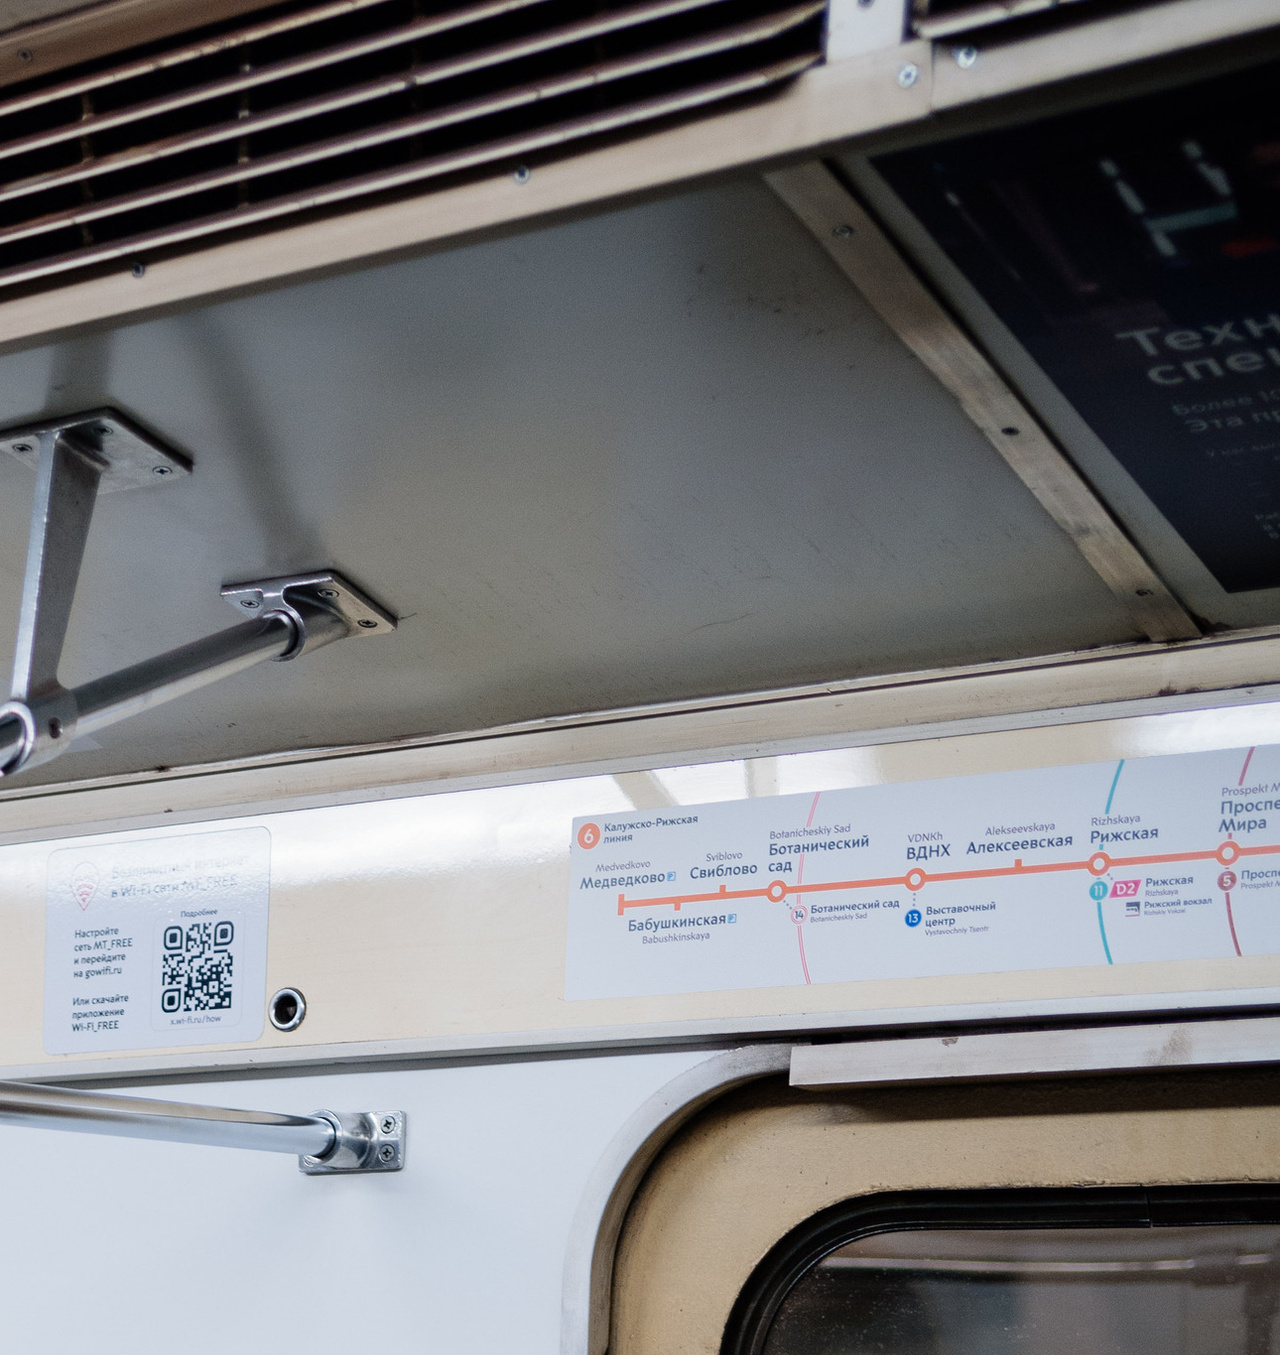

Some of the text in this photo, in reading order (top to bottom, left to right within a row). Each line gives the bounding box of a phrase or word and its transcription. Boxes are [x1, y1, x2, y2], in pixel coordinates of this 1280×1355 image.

[1221, 782, 1269, 797] Prospekt
[603, 815, 699, 833] Калужско-Рижская
[1090, 814, 1141, 827] Rizhskaya
[1218, 818, 1268, 833] Мира
[769, 823, 852, 840] Botanicheskiy Sad
[985, 822, 1057, 837] Alekseevskaya
[1090, 828, 1160, 844] Рижская
[603, 834, 634, 844] линия
[907, 831, 944, 843] VDNKh
[769, 834, 870, 856] Ботанический
[966, 835, 1074, 855] Алексеевская
[706, 851, 744, 862] Sviblovo
[906, 843, 952, 861] ВДНХ
[595, 860, 652, 873] Medvedkovo
[689, 863, 759, 880] Свиблово
[768, 861, 793, 873] сад
[579, 872, 666, 890] Медведково
[1144, 876, 1195, 888] Рижская
[1093, 884, 1104, 897] 11
[1115, 882, 1136, 896] D2
[810, 899, 900, 914] Ботанический сад
[925, 901, 997, 916] Выставочный
[1143, 897, 1213, 909] Рижский вокзал
[180, 908, 218, 918] Подробнее
[794, 910, 805, 920] 14
[907, 912, 919, 924] 13
[628, 914, 727, 933] Бабушкинская
[924, 917, 956, 928] центр
[74, 927, 119, 939] Настройте
[641, 931, 711, 945] Babushkinskaya
[73, 937, 133, 952] сеть MT_FREE
[81, 953, 126, 965] перейдите
[73, 966, 122, 979] на gowifi.ru
[72, 994, 129, 1006] Или скачайте
[72, 1008, 125, 1021] приложение
